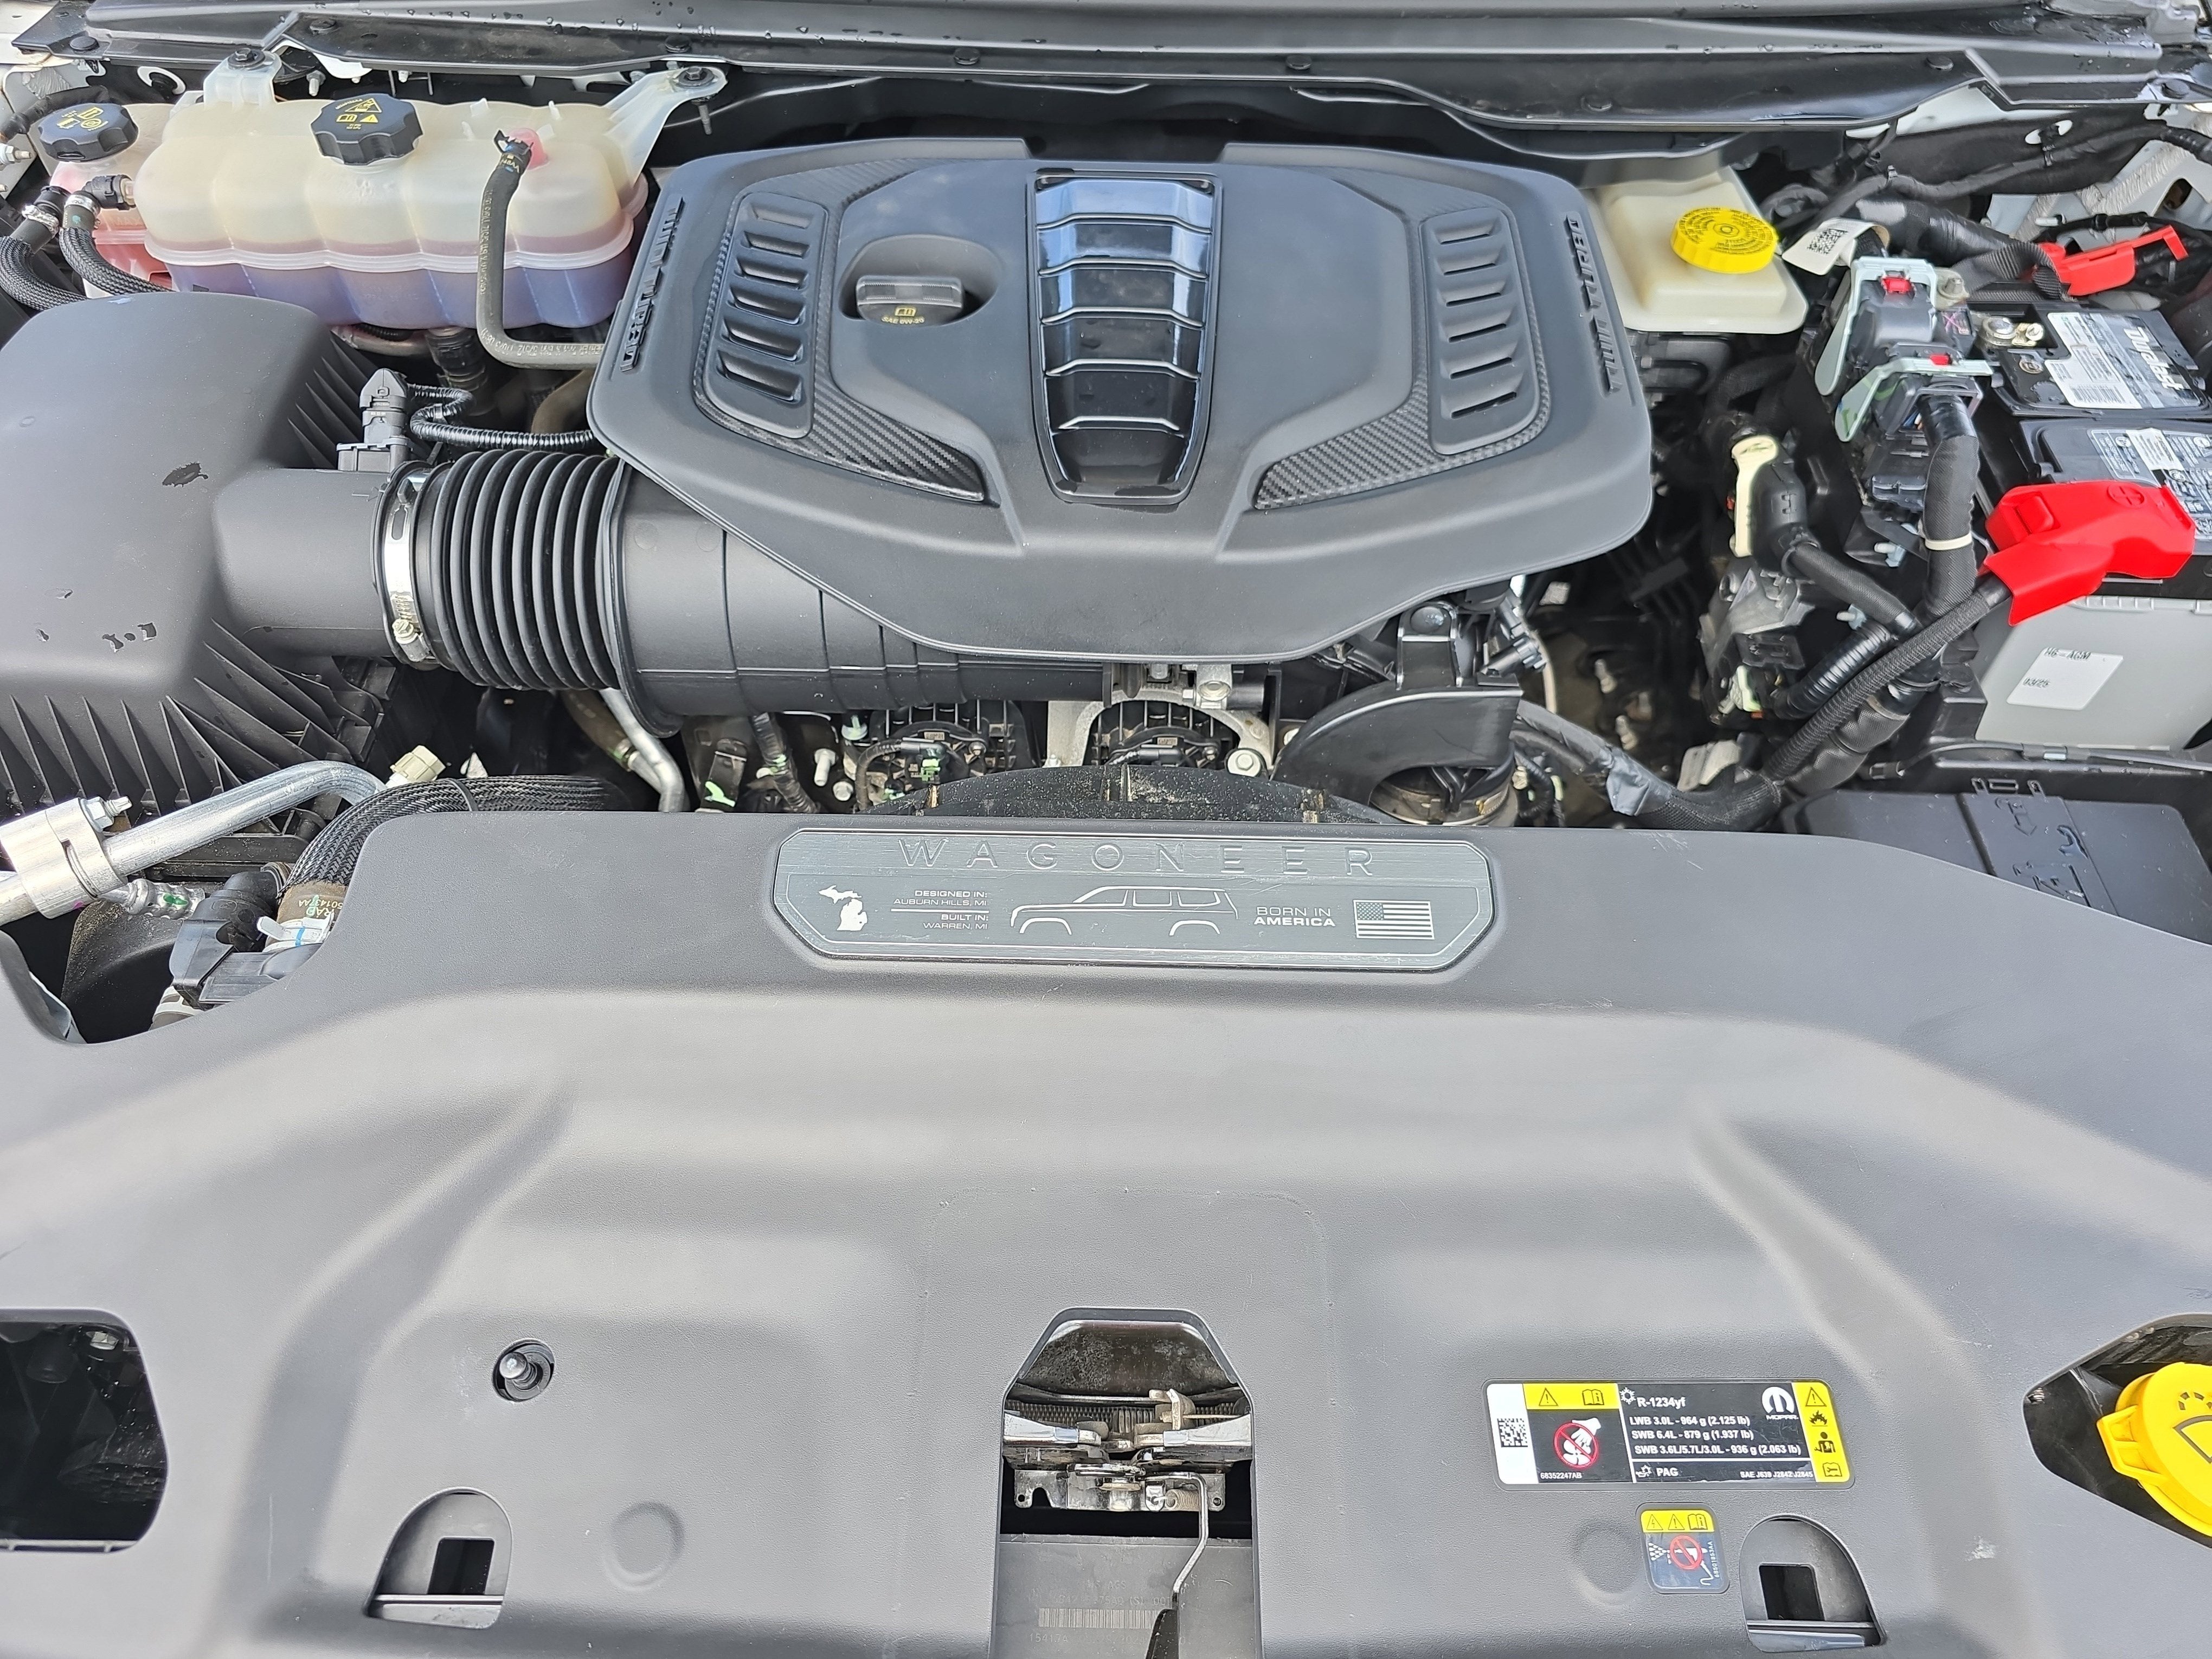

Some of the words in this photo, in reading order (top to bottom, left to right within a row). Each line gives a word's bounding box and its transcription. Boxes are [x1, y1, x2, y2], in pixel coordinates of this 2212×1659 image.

[899, 316, 925, 324] 0W-20
[2123, 326, 2184, 390] Duralast
[2023, 678, 2050, 687] 03/25
[898, 838, 1373, 876] WAGONEER
[1256, 906, 1310, 916] BORN
[1314, 908, 1331, 916] IN
[1253, 917, 1335, 926] AMERICA
[1636, 1397, 1686, 1409] R-1234yf
[1629, 1416, 1652, 1425] LWB
[1653, 1416, 1674, 1425] 3.0L
[1681, 1416, 1698, 1425] 964
[1699, 1418, 1707, 1426] g
[1708, 1416, 1736, 1426] (2.125
[1737, 1416, 1750, 1426] lb)
[1631, 1430, 1655, 1439] SWB
[1656, 1430, 1678, 1439] 6.4L
[1683, 1430, 1701, 1438] 879
[1702, 1432, 1710, 1441] g
[1711, 1430, 1739, 1440] (1.937
[1740, 1430, 1754, 1440] lb)
[1634, 1445, 1658, 1454] SWB
[1660, 1445, 1725, 1454] 3.6L/5.7L/3.0L
[1731, 1445, 1748, 1454] 936
[1750, 1446, 1757, 1455] g
[1758, 1444, 1787, 1455] (2.063
[1789, 1445, 1801, 1455] lb)
[1656, 1468, 1679, 1477] PAG
